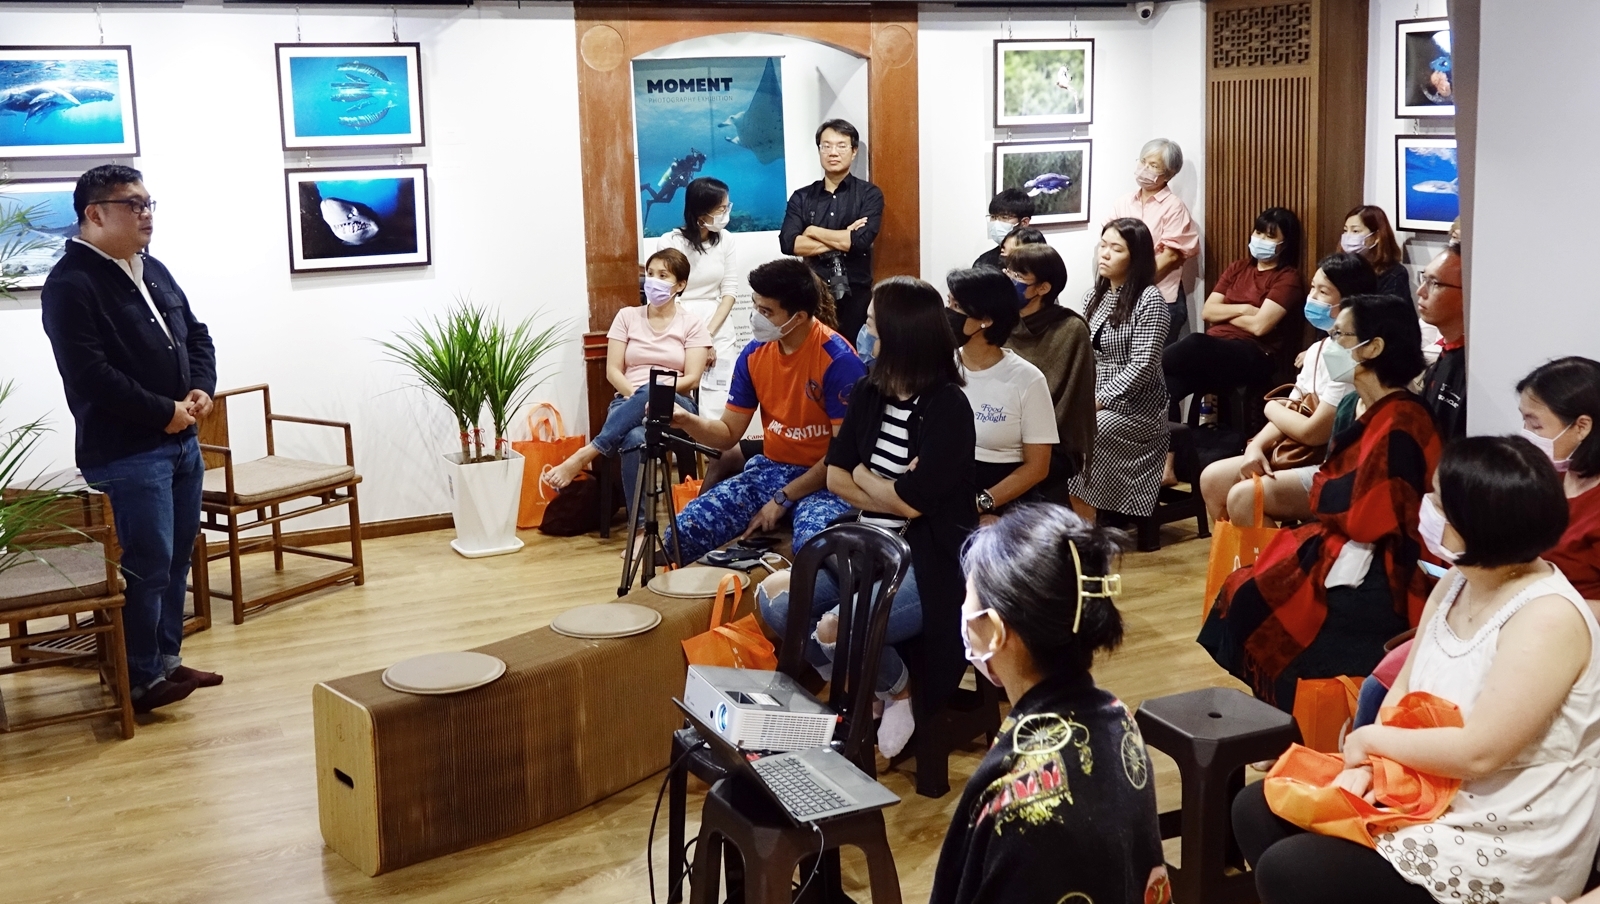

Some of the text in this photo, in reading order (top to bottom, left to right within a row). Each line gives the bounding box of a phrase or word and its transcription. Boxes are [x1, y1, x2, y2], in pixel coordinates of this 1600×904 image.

[647, 77, 733, 94] MOMENT
[648, 95, 733, 104] PHOTOGRAPHY EXHIBITION
[981, 403, 1004, 413] Food
[975, 412, 1007, 423] Thought
[785, 424, 830, 441] SENTUL
